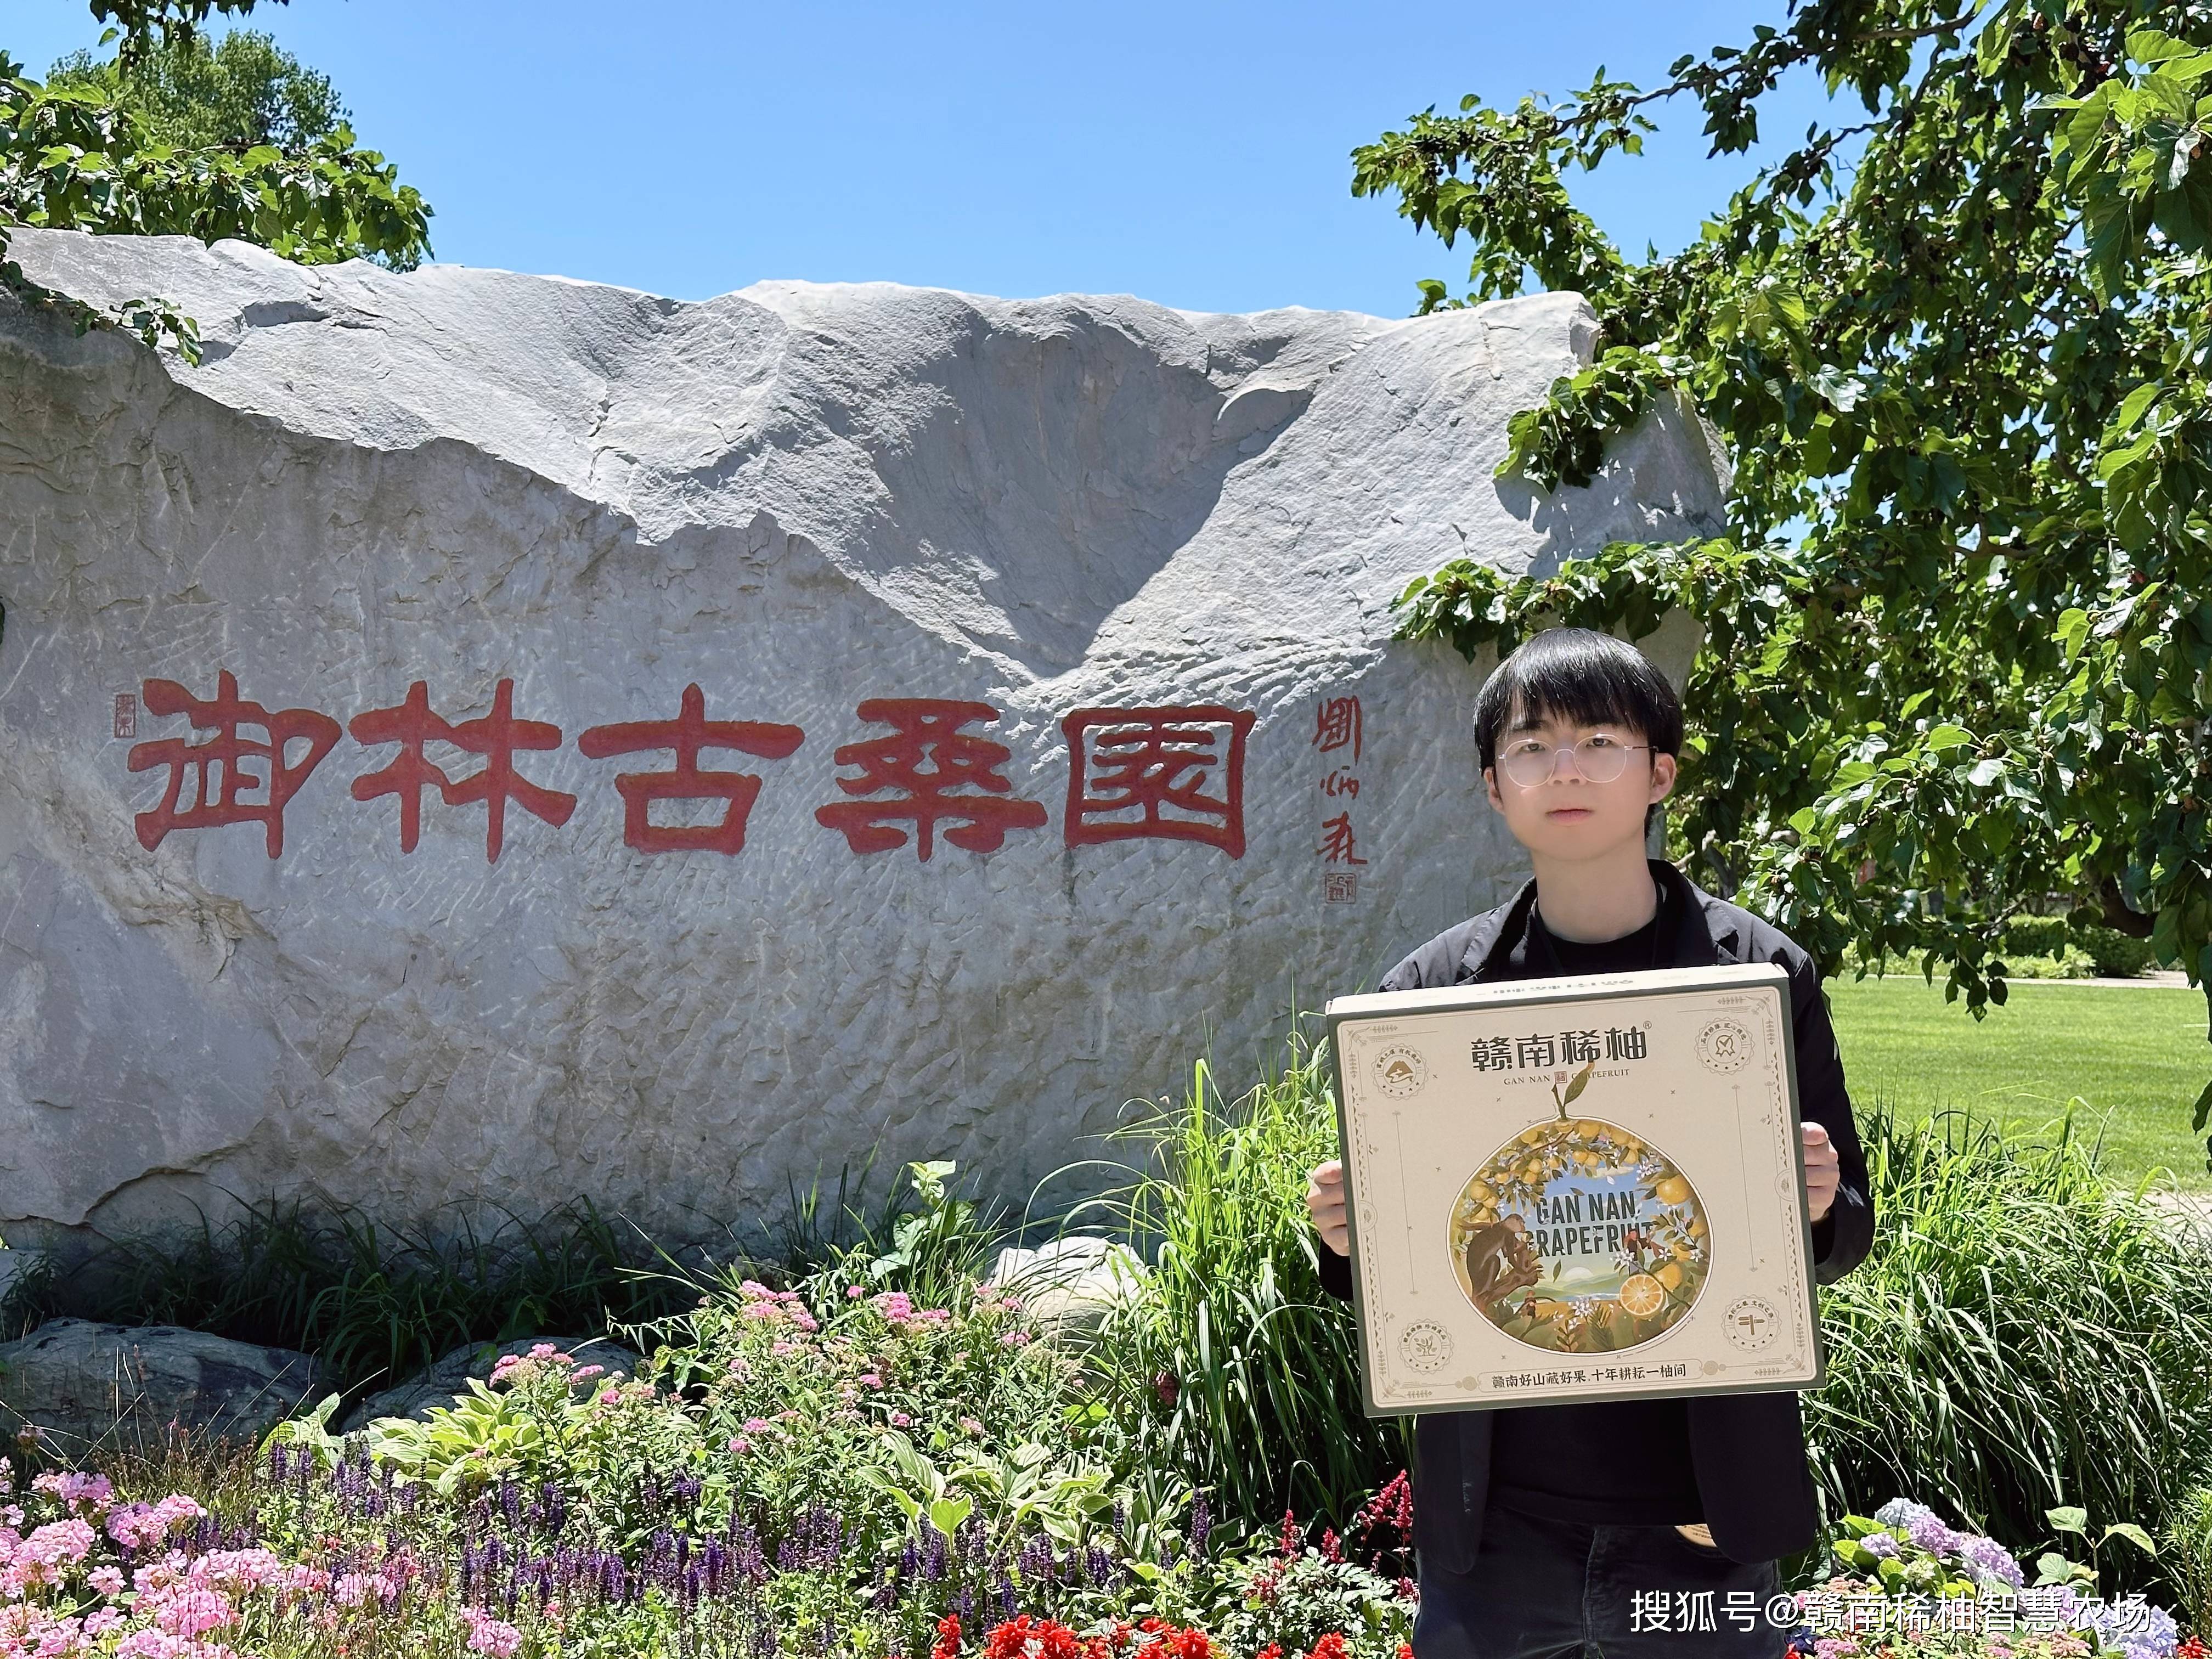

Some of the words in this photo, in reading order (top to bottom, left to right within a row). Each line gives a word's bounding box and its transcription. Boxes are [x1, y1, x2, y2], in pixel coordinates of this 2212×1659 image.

[1471, 1025, 1647, 1071] 赣南稀柚
[1504, 1077, 1525, 1085] GAN
[1529, 1075, 1550, 1083] NAN
[1571, 1069, 1629, 1079] GPEFRUIT
[1537, 1195, 1581, 1225] GAN
[1588, 1191, 1637, 1222] NAN
